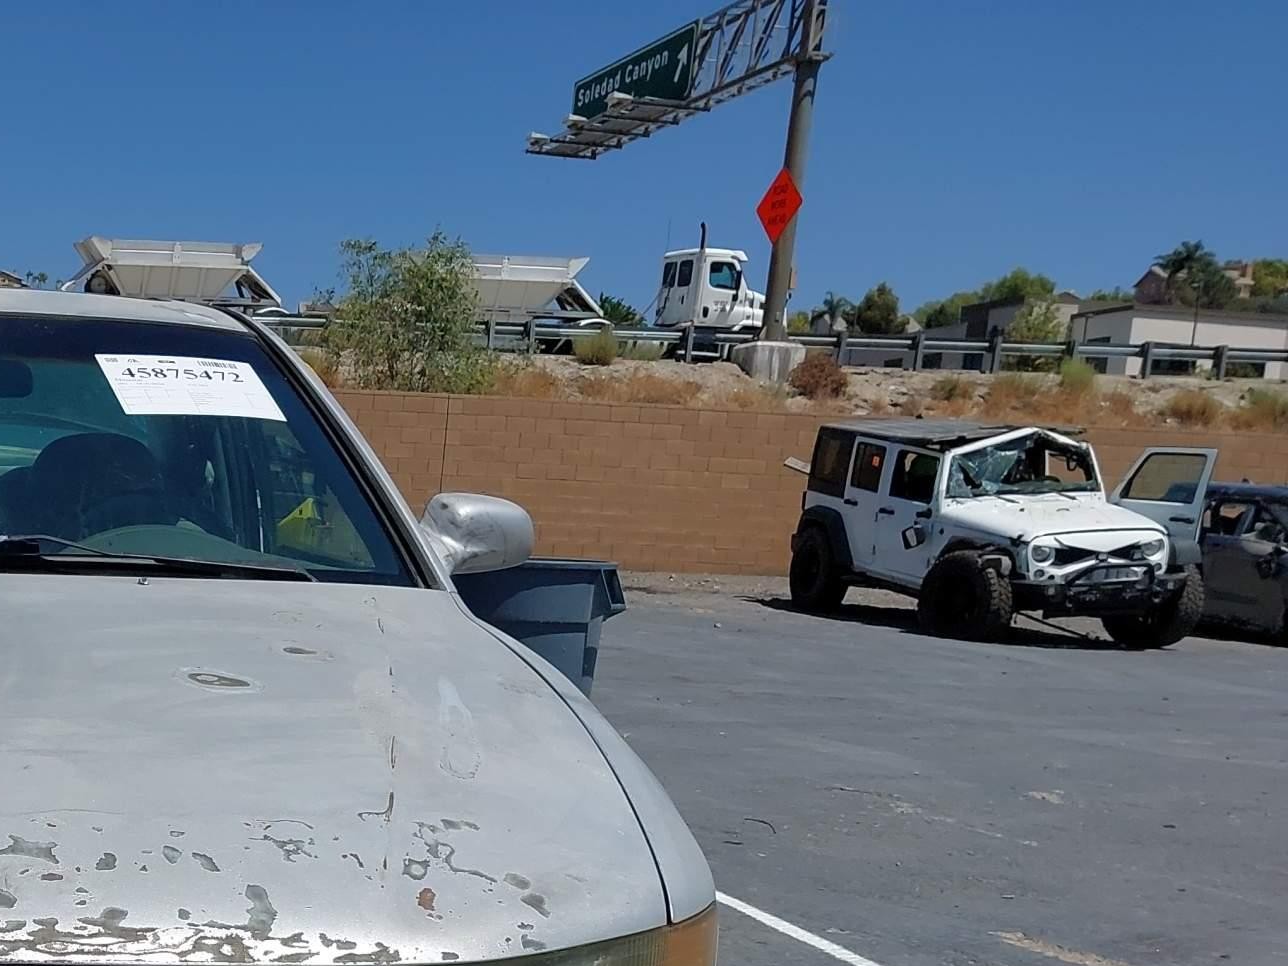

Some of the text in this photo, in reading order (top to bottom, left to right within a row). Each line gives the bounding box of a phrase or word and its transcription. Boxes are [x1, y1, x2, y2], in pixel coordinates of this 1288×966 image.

[577, 50, 669, 107] Soledad Canyon
[121, 366, 245, 384] 45875472
